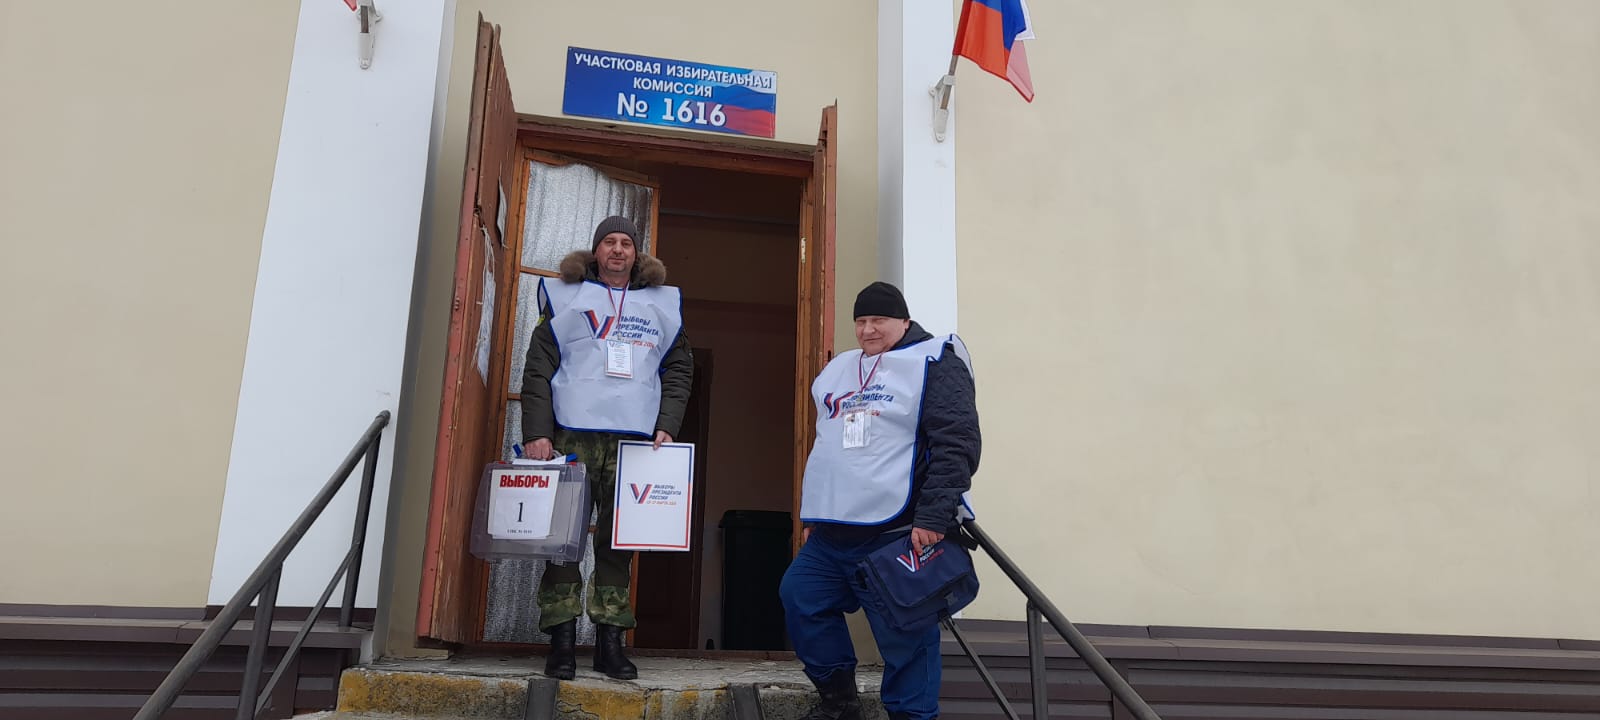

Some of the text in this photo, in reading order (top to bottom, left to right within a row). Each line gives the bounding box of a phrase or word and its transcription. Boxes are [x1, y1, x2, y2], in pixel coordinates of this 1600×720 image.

[574, 52, 772, 89] УЧАСТКОВАЯ ИЗБИРАТЕЛЬНАЯ
[633, 77, 713, 98] КОМИССИЯ
[616, 92, 727, 127] № 1616
[499, 474, 550, 489] ВЫБОРЫ
[517, 501, 524, 523] 1
